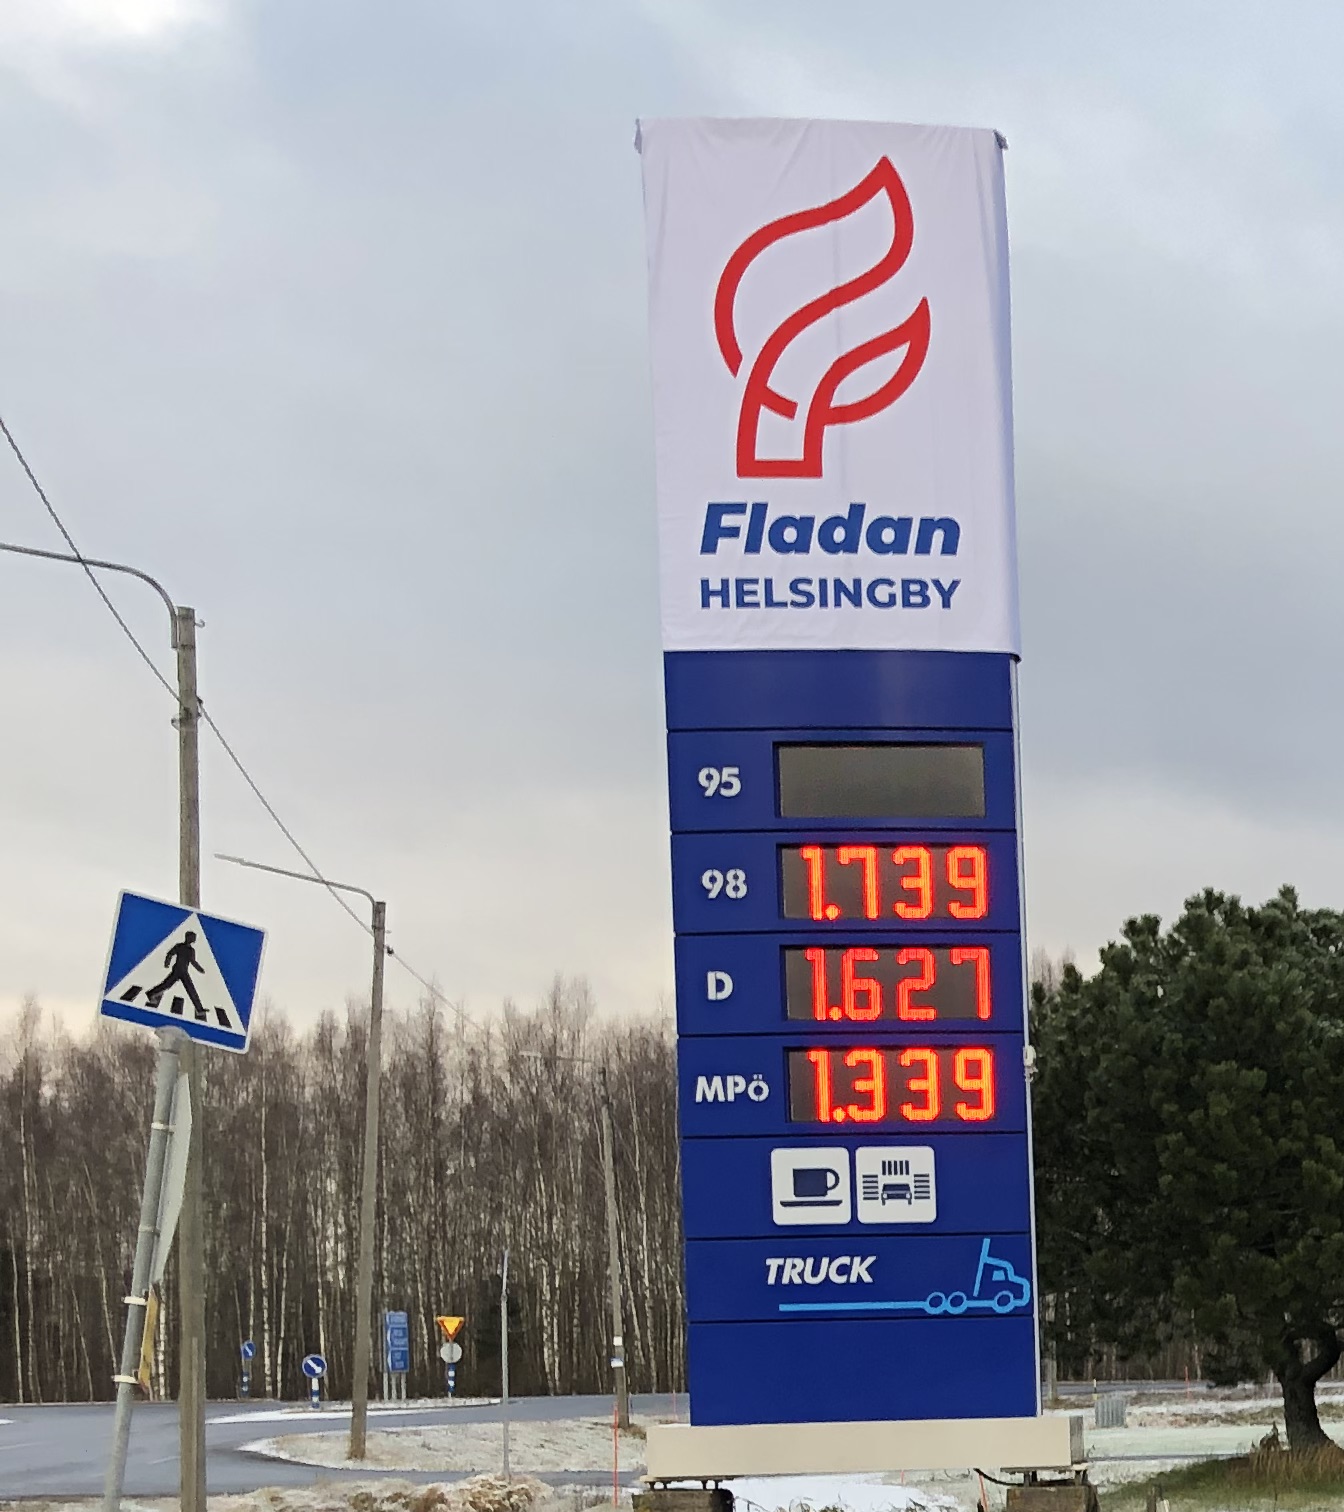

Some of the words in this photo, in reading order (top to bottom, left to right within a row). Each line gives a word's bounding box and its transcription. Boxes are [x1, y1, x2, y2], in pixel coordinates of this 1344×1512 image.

[700, 502, 961, 556] Fladan
[700, 577, 961, 609] HELSINGBY
[698, 766, 742, 798] 95
[701, 868, 748, 899] 98
[801, 845, 989, 920] 1.739
[706, 970, 734, 1001] D
[805, 947, 992, 1022] 1.627
[806, 1048, 995, 1123] 1.339
[765, 1255, 877, 1286] TRUCK
